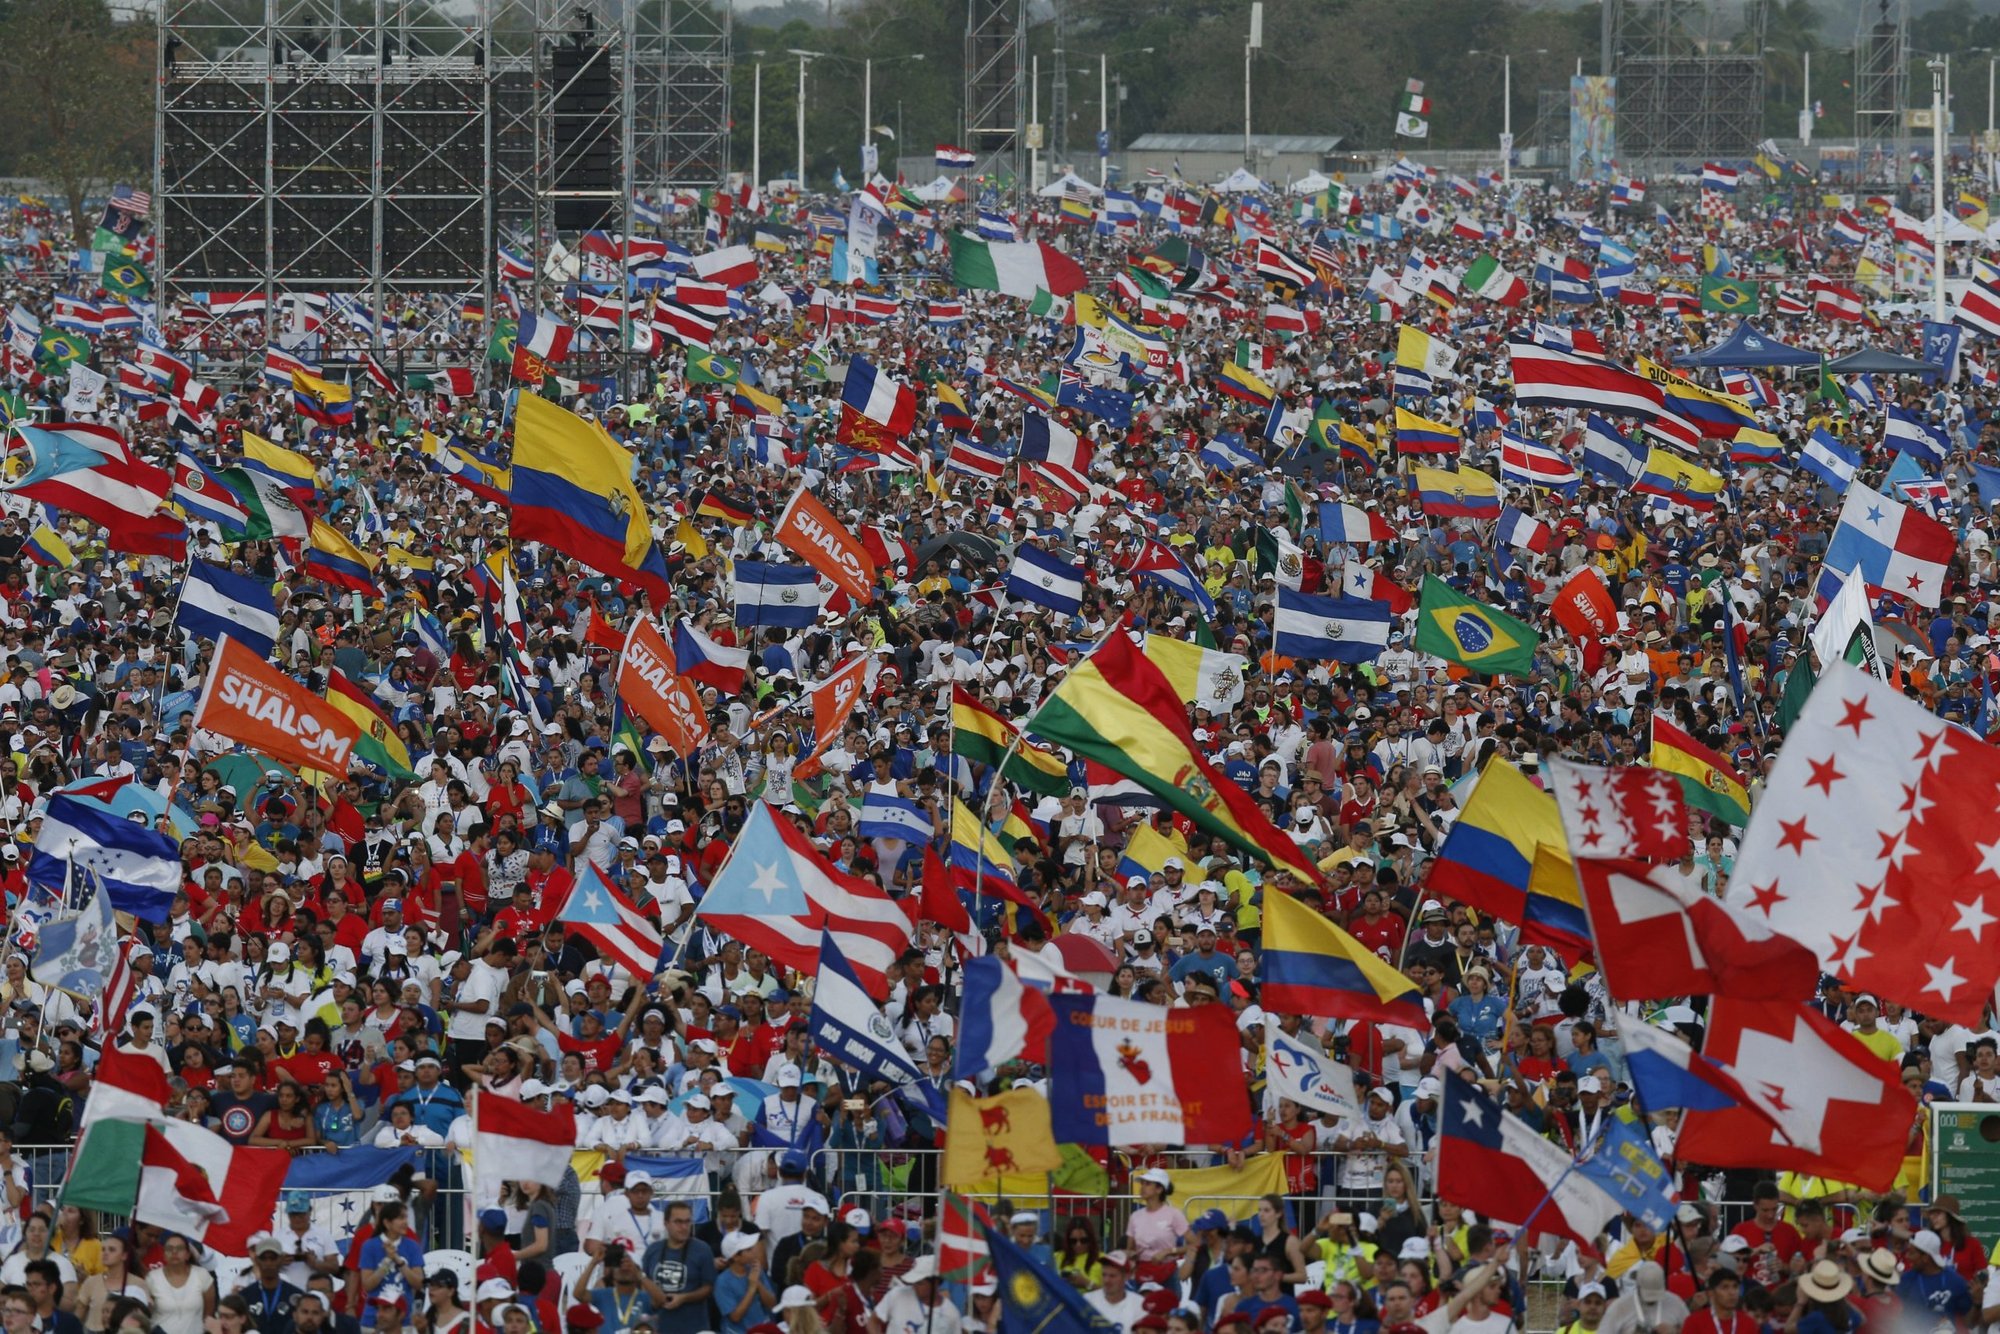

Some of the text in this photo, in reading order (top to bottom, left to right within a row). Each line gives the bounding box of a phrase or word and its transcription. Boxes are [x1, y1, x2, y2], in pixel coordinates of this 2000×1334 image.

[792, 511, 871, 592] SHALOM
[626, 643, 702, 739] SHALOM
[219, 675, 351, 763] SHALOM
[819, 1022, 842, 1044] DIOS
[844, 1038, 876, 1064] UNION
[1070, 1011, 1195, 1033] COEUR DE JESUS
[1083, 1094, 1136, 1109] ESPOIR
[1140, 1094, 1157, 1107] ET
[1095, 1113, 1113, 1126] DE
[1118, 1112, 1136, 1124] LA
